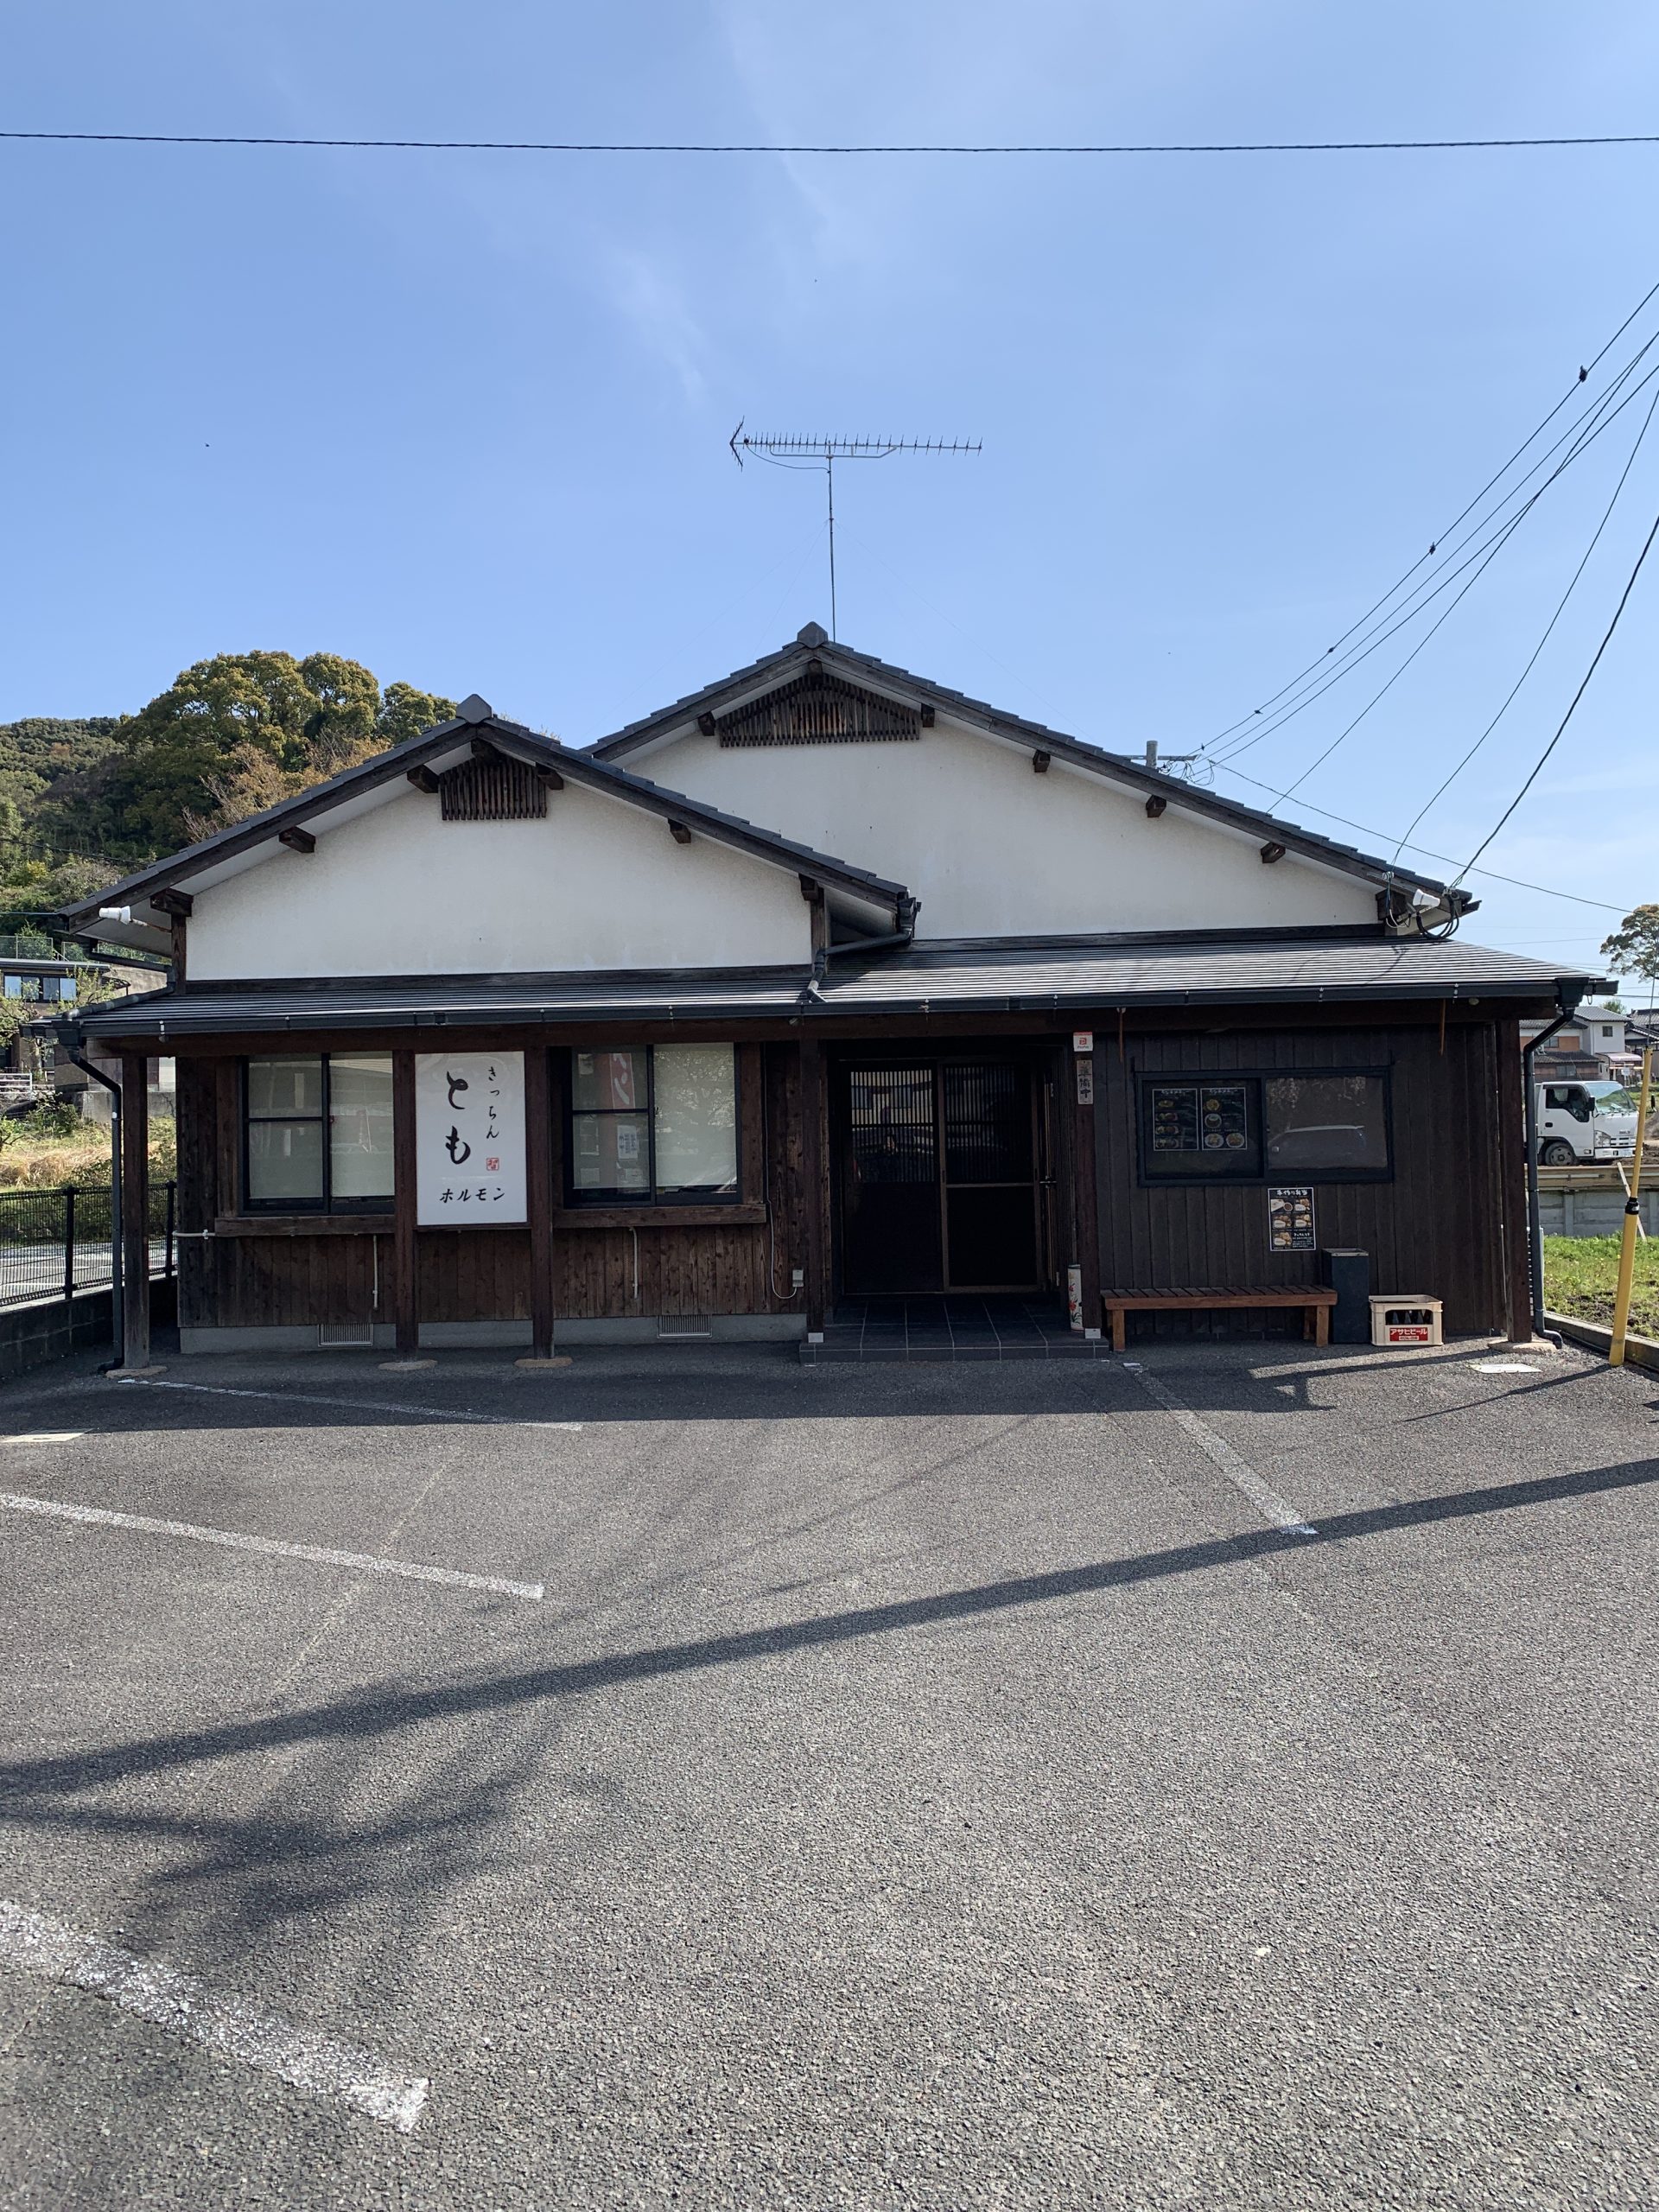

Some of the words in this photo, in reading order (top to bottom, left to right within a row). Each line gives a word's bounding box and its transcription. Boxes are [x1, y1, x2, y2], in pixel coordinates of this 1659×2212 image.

[445, 1071, 471, 1165] とも
[439, 1187, 505, 1204] ホルモン
